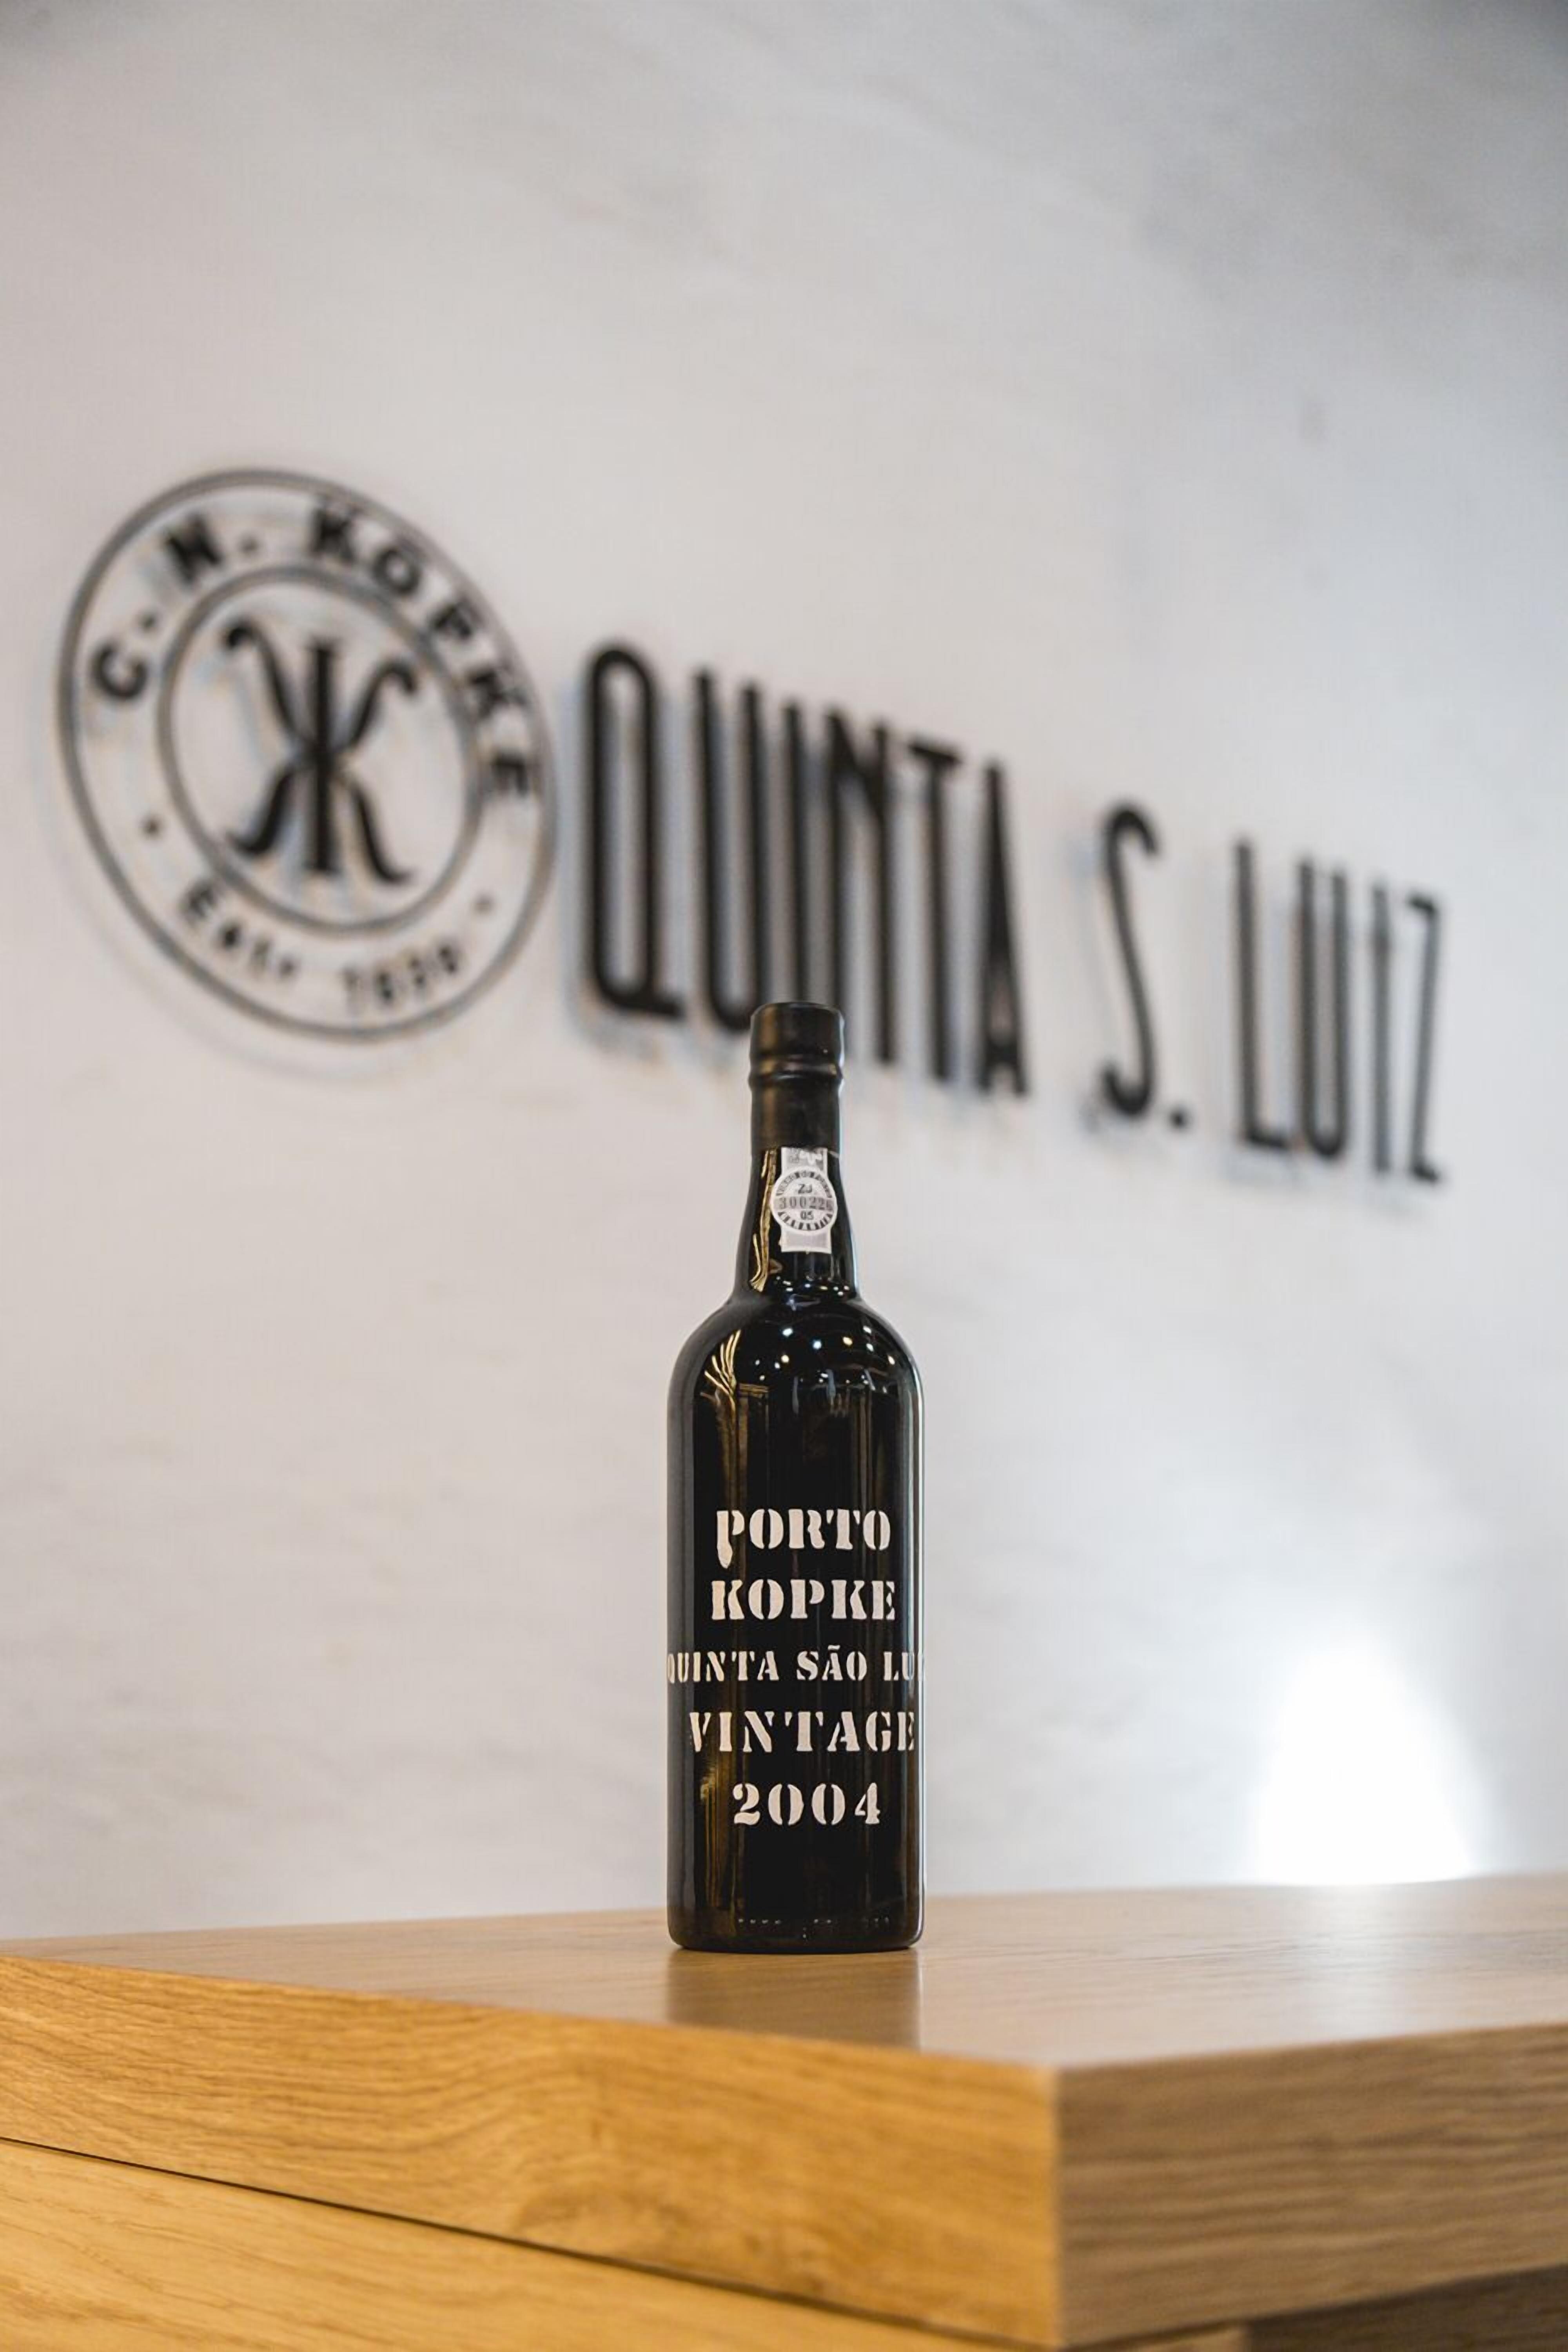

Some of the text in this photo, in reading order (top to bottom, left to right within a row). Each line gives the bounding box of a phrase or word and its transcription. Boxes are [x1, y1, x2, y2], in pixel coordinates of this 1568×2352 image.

[312, 500, 531, 798] KOPKE
[584, 643, 1026, 1096] QUINTA
[1098, 803, 1187, 1129] S.
[1236, 839, 1439, 1184] LUIZ
[716, 1509, 891, 1568] PORTO
[711, 1579, 895, 1620] KOPKE
[796, 1645, 867, 1681] SÃO
[689, 1711, 915, 1753] VINTAGE
[733, 1782, 880, 1826] 2004
